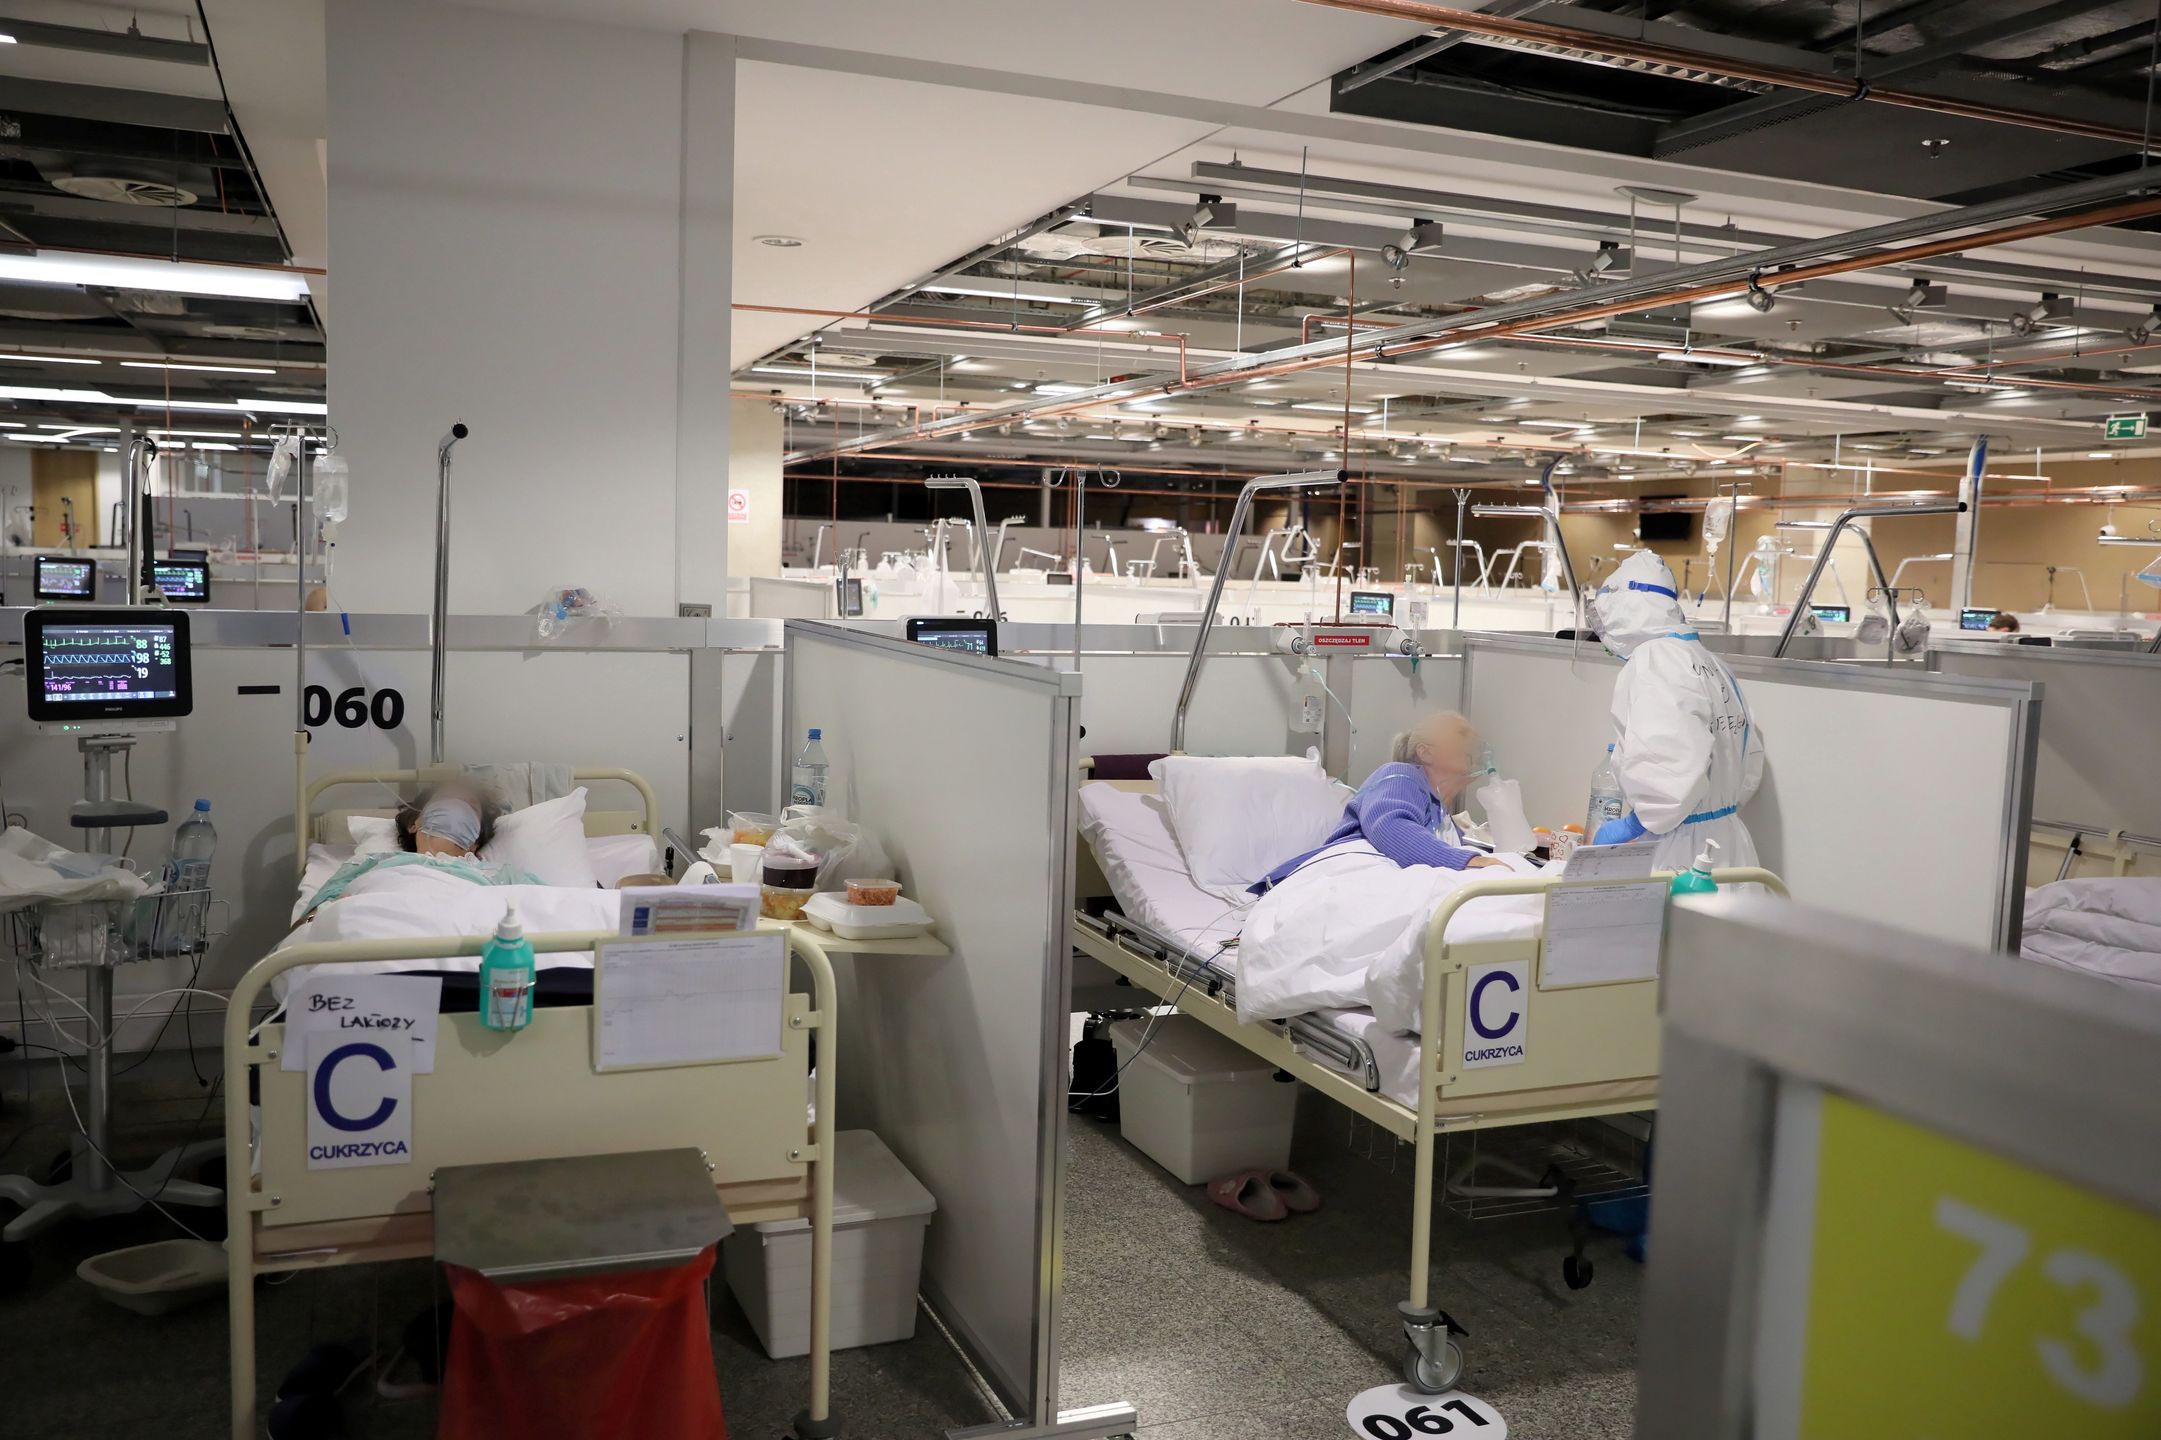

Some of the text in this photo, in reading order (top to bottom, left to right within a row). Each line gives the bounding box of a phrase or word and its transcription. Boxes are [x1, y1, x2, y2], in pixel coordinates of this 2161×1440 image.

[136, 639, 148, 649] 88
[136, 652, 150, 664] 98
[136, 667, 149, 678] 19
[304, 685, 404, 730] 060
[308, 994, 355, 1012] BEZ
[1469, 970, 1520, 1039] C
[1465, 1044, 1523, 1061] CUKRZYCA
[313, 1042, 398, 1131] C
[310, 1141, 408, 1160] CUKRZYCA
[1934, 1195, 2144, 1410] 73
[1362, 1400, 1490, 1440] 061
